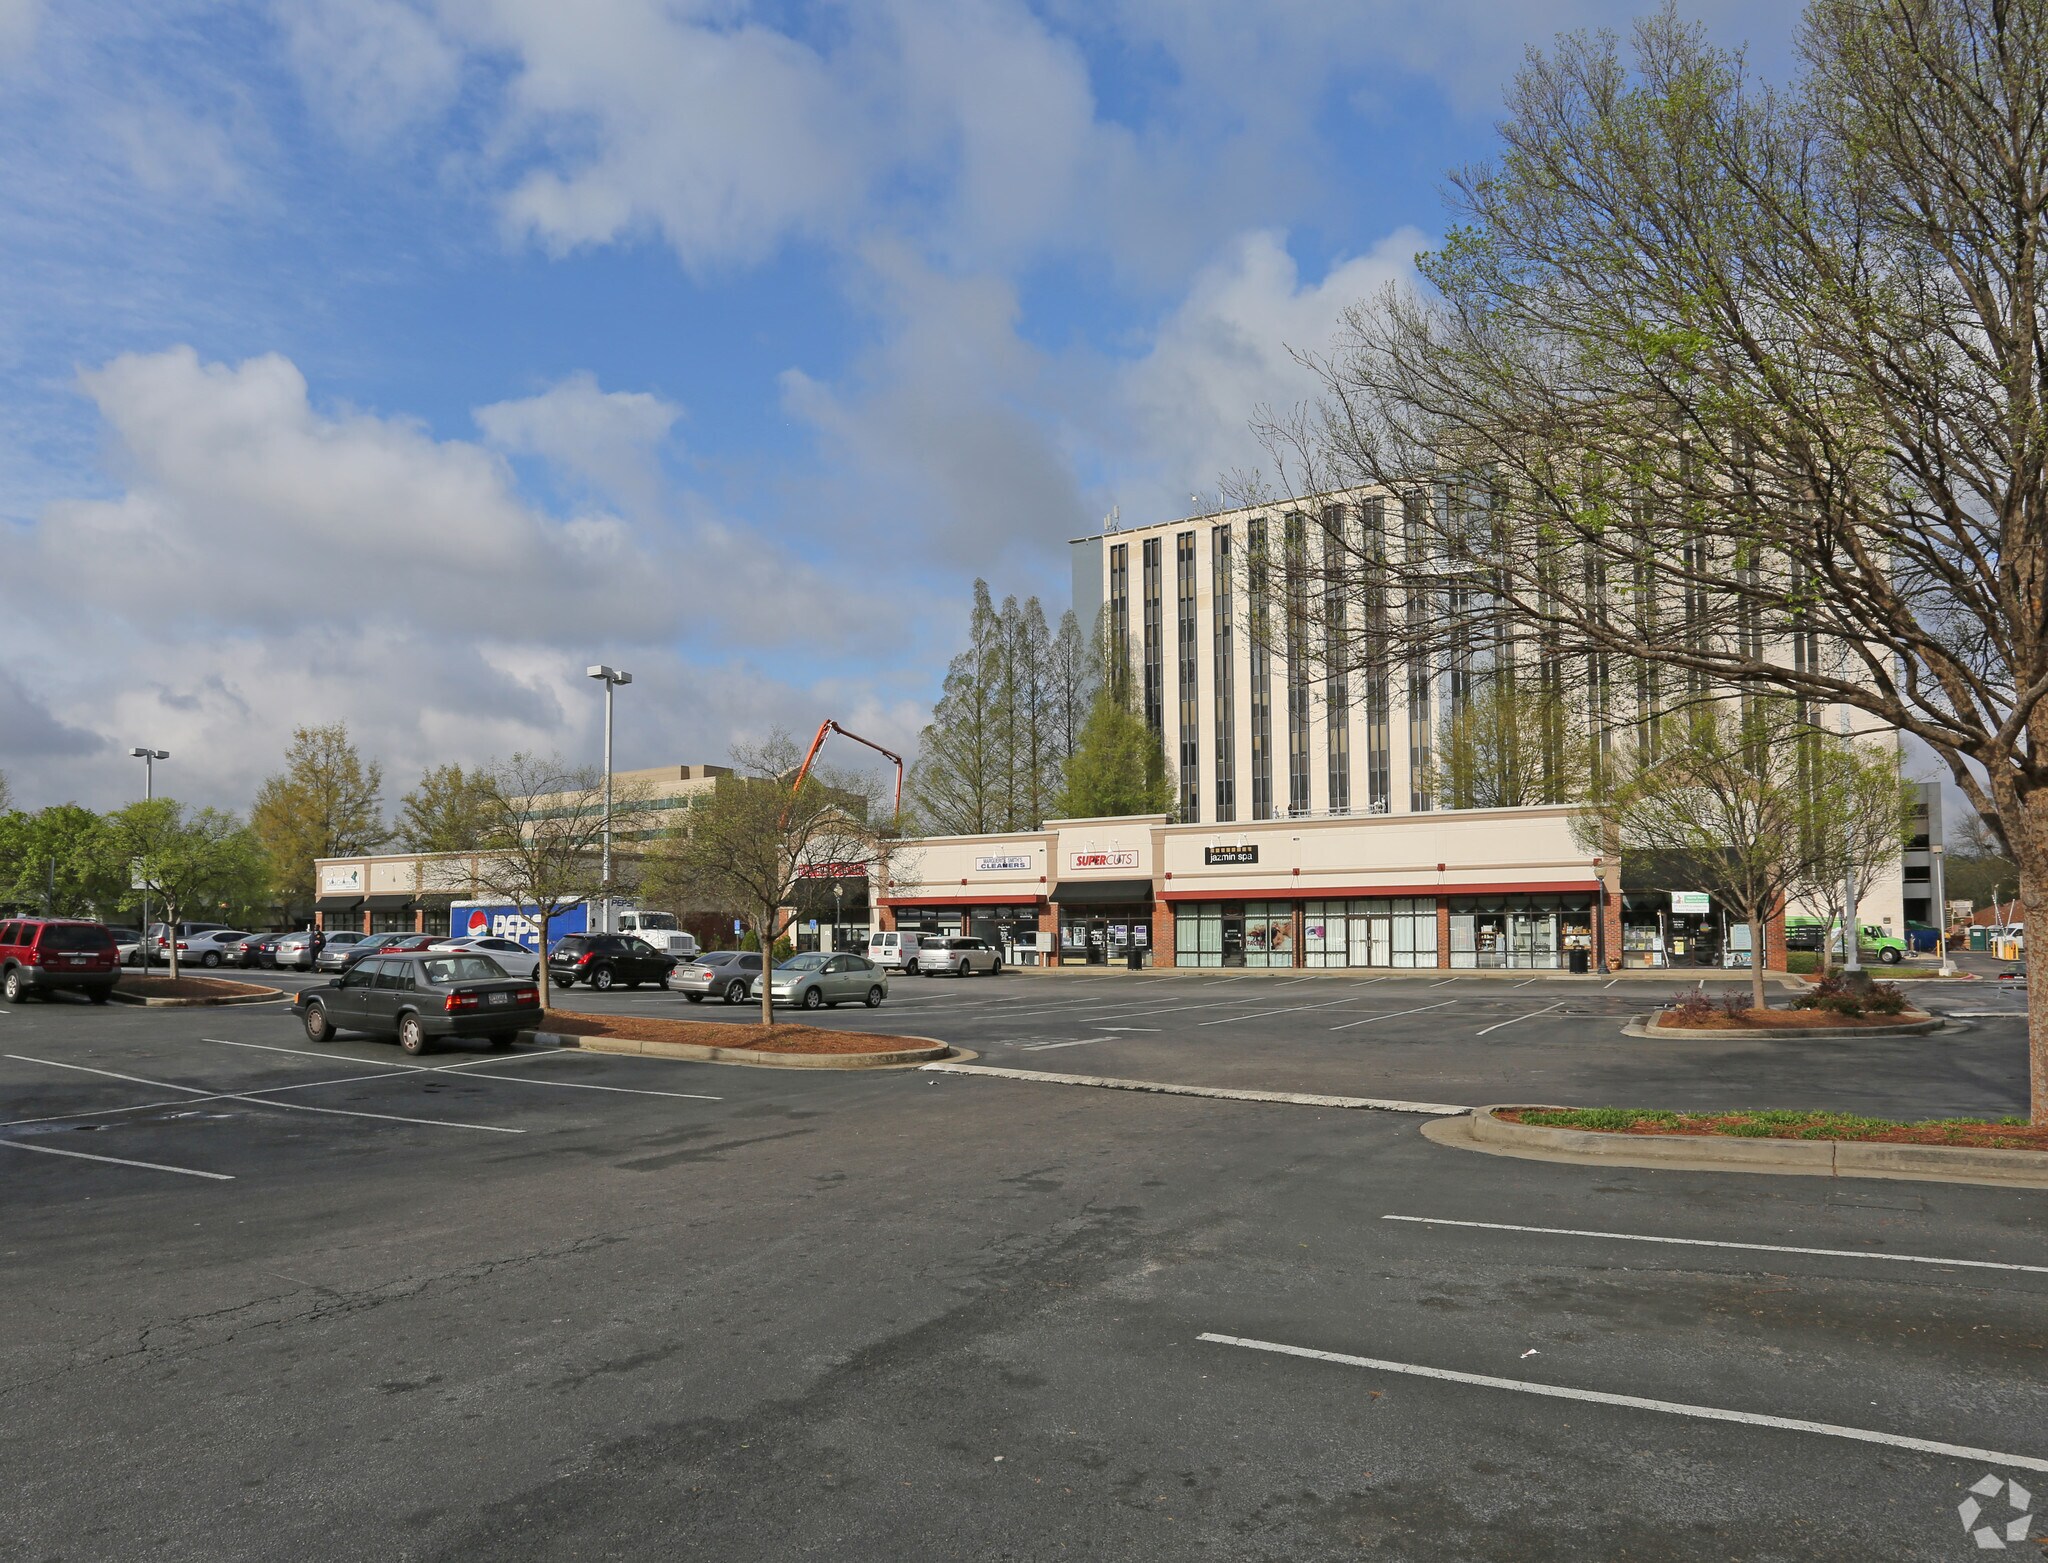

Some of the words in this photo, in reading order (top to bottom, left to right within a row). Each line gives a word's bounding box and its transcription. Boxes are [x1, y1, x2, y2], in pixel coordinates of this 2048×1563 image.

[1076, 853, 1133, 866] SUPERCUTS
[1210, 852, 1235, 863] jazmin
[1237, 853, 1253, 862] spa
[493, 914, 544, 944] PEPS
